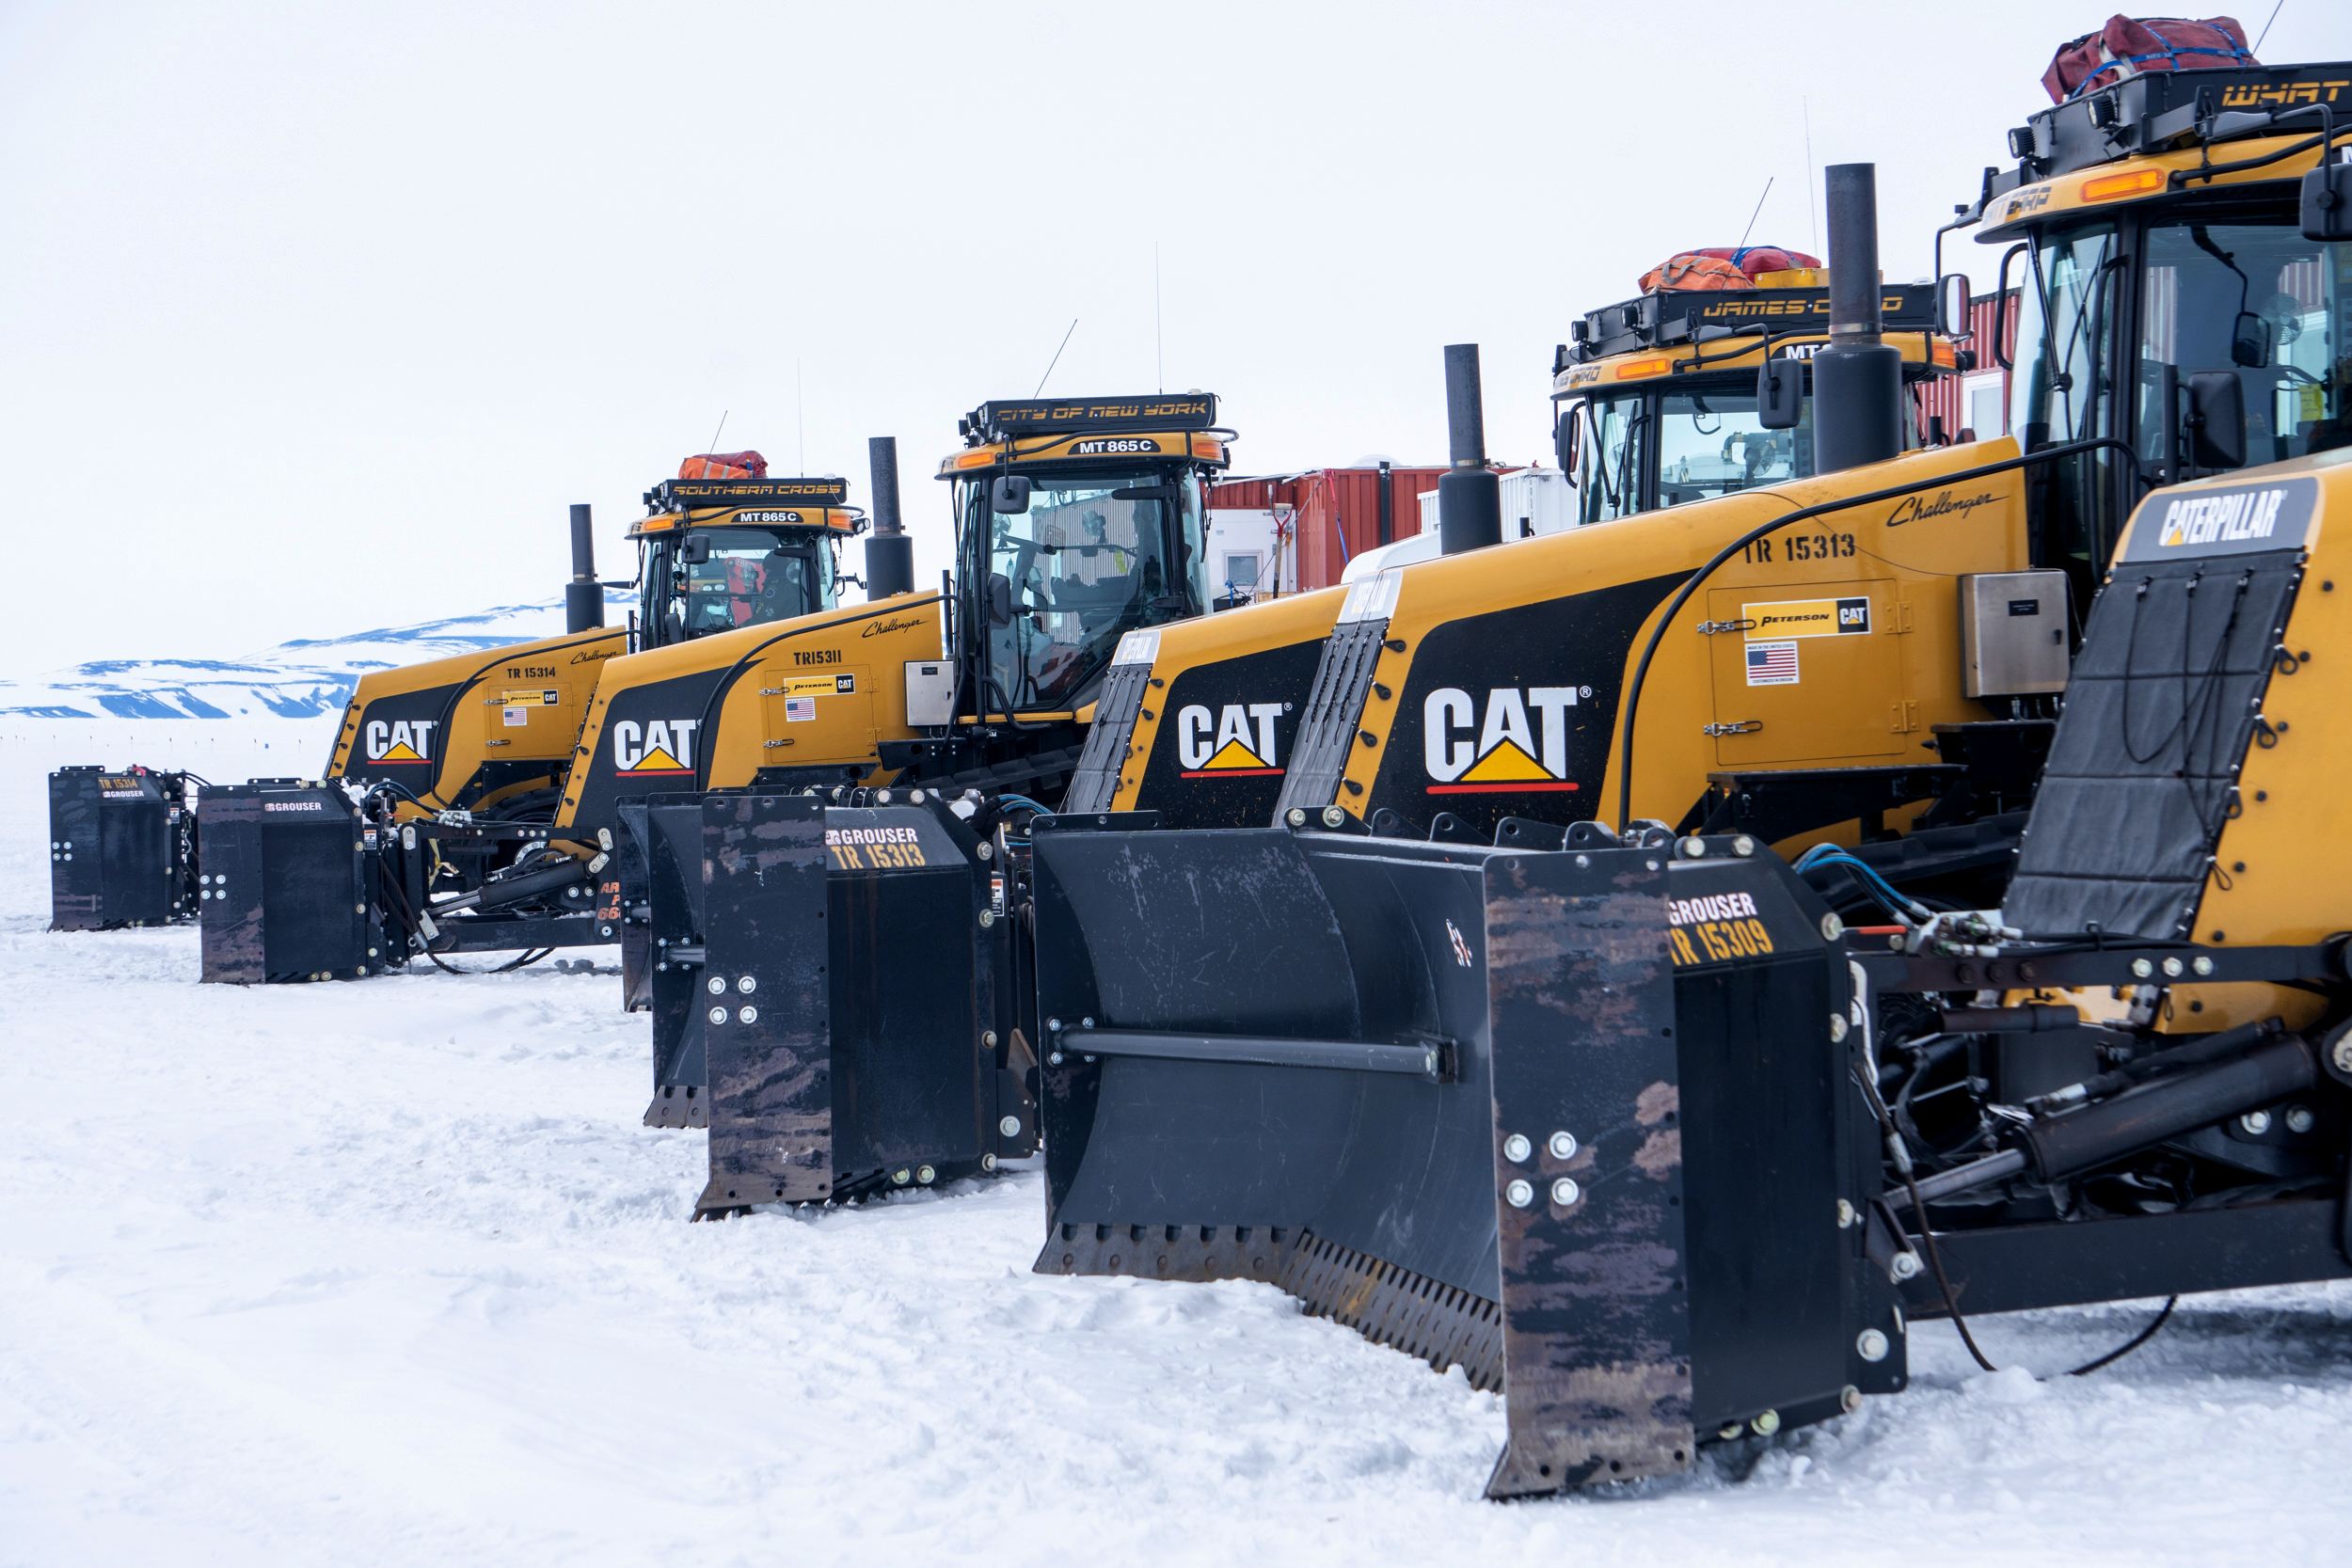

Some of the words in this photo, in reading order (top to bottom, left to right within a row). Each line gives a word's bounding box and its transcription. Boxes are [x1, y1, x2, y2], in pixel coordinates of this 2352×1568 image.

[1704, 300, 1806, 316] JAMES
[997, 409, 1047, 421] CITY
[1052, 407, 1084, 420] OF
[1089, 405, 1139, 418] NEW
[1143, 403, 1207, 415] YORK
[674, 486, 773, 496] SOUTHERN
[777, 485, 841, 495] CROSS
[1886, 491, 2010, 528] Challenger
[2159, 489, 2283, 546] CATERPILLAR
[1786, 533, 1855, 562] 15313
[1761, 613, 1829, 627] PETERSON
[1840, 607, 1867, 625] CAT
[862, 619, 930, 639] Challenger
[507, 668, 520, 678] TR
[525, 667, 556, 678] 15314
[837, 679, 852, 689] CAT
[367, 721, 432, 760] CAT
[613, 720, 696, 770] CAT
[98, 778, 112, 789] TR
[114, 778, 138, 789] 15314
[276, 801, 322, 811] GROUSER
[840, 828, 918, 845] GROUSER
[831, 845, 864, 870] TR
[866, 843, 926, 868] 15313
[1668, 892, 1757, 926] GROUSER
[1696, 918, 1773, 960] 15309
